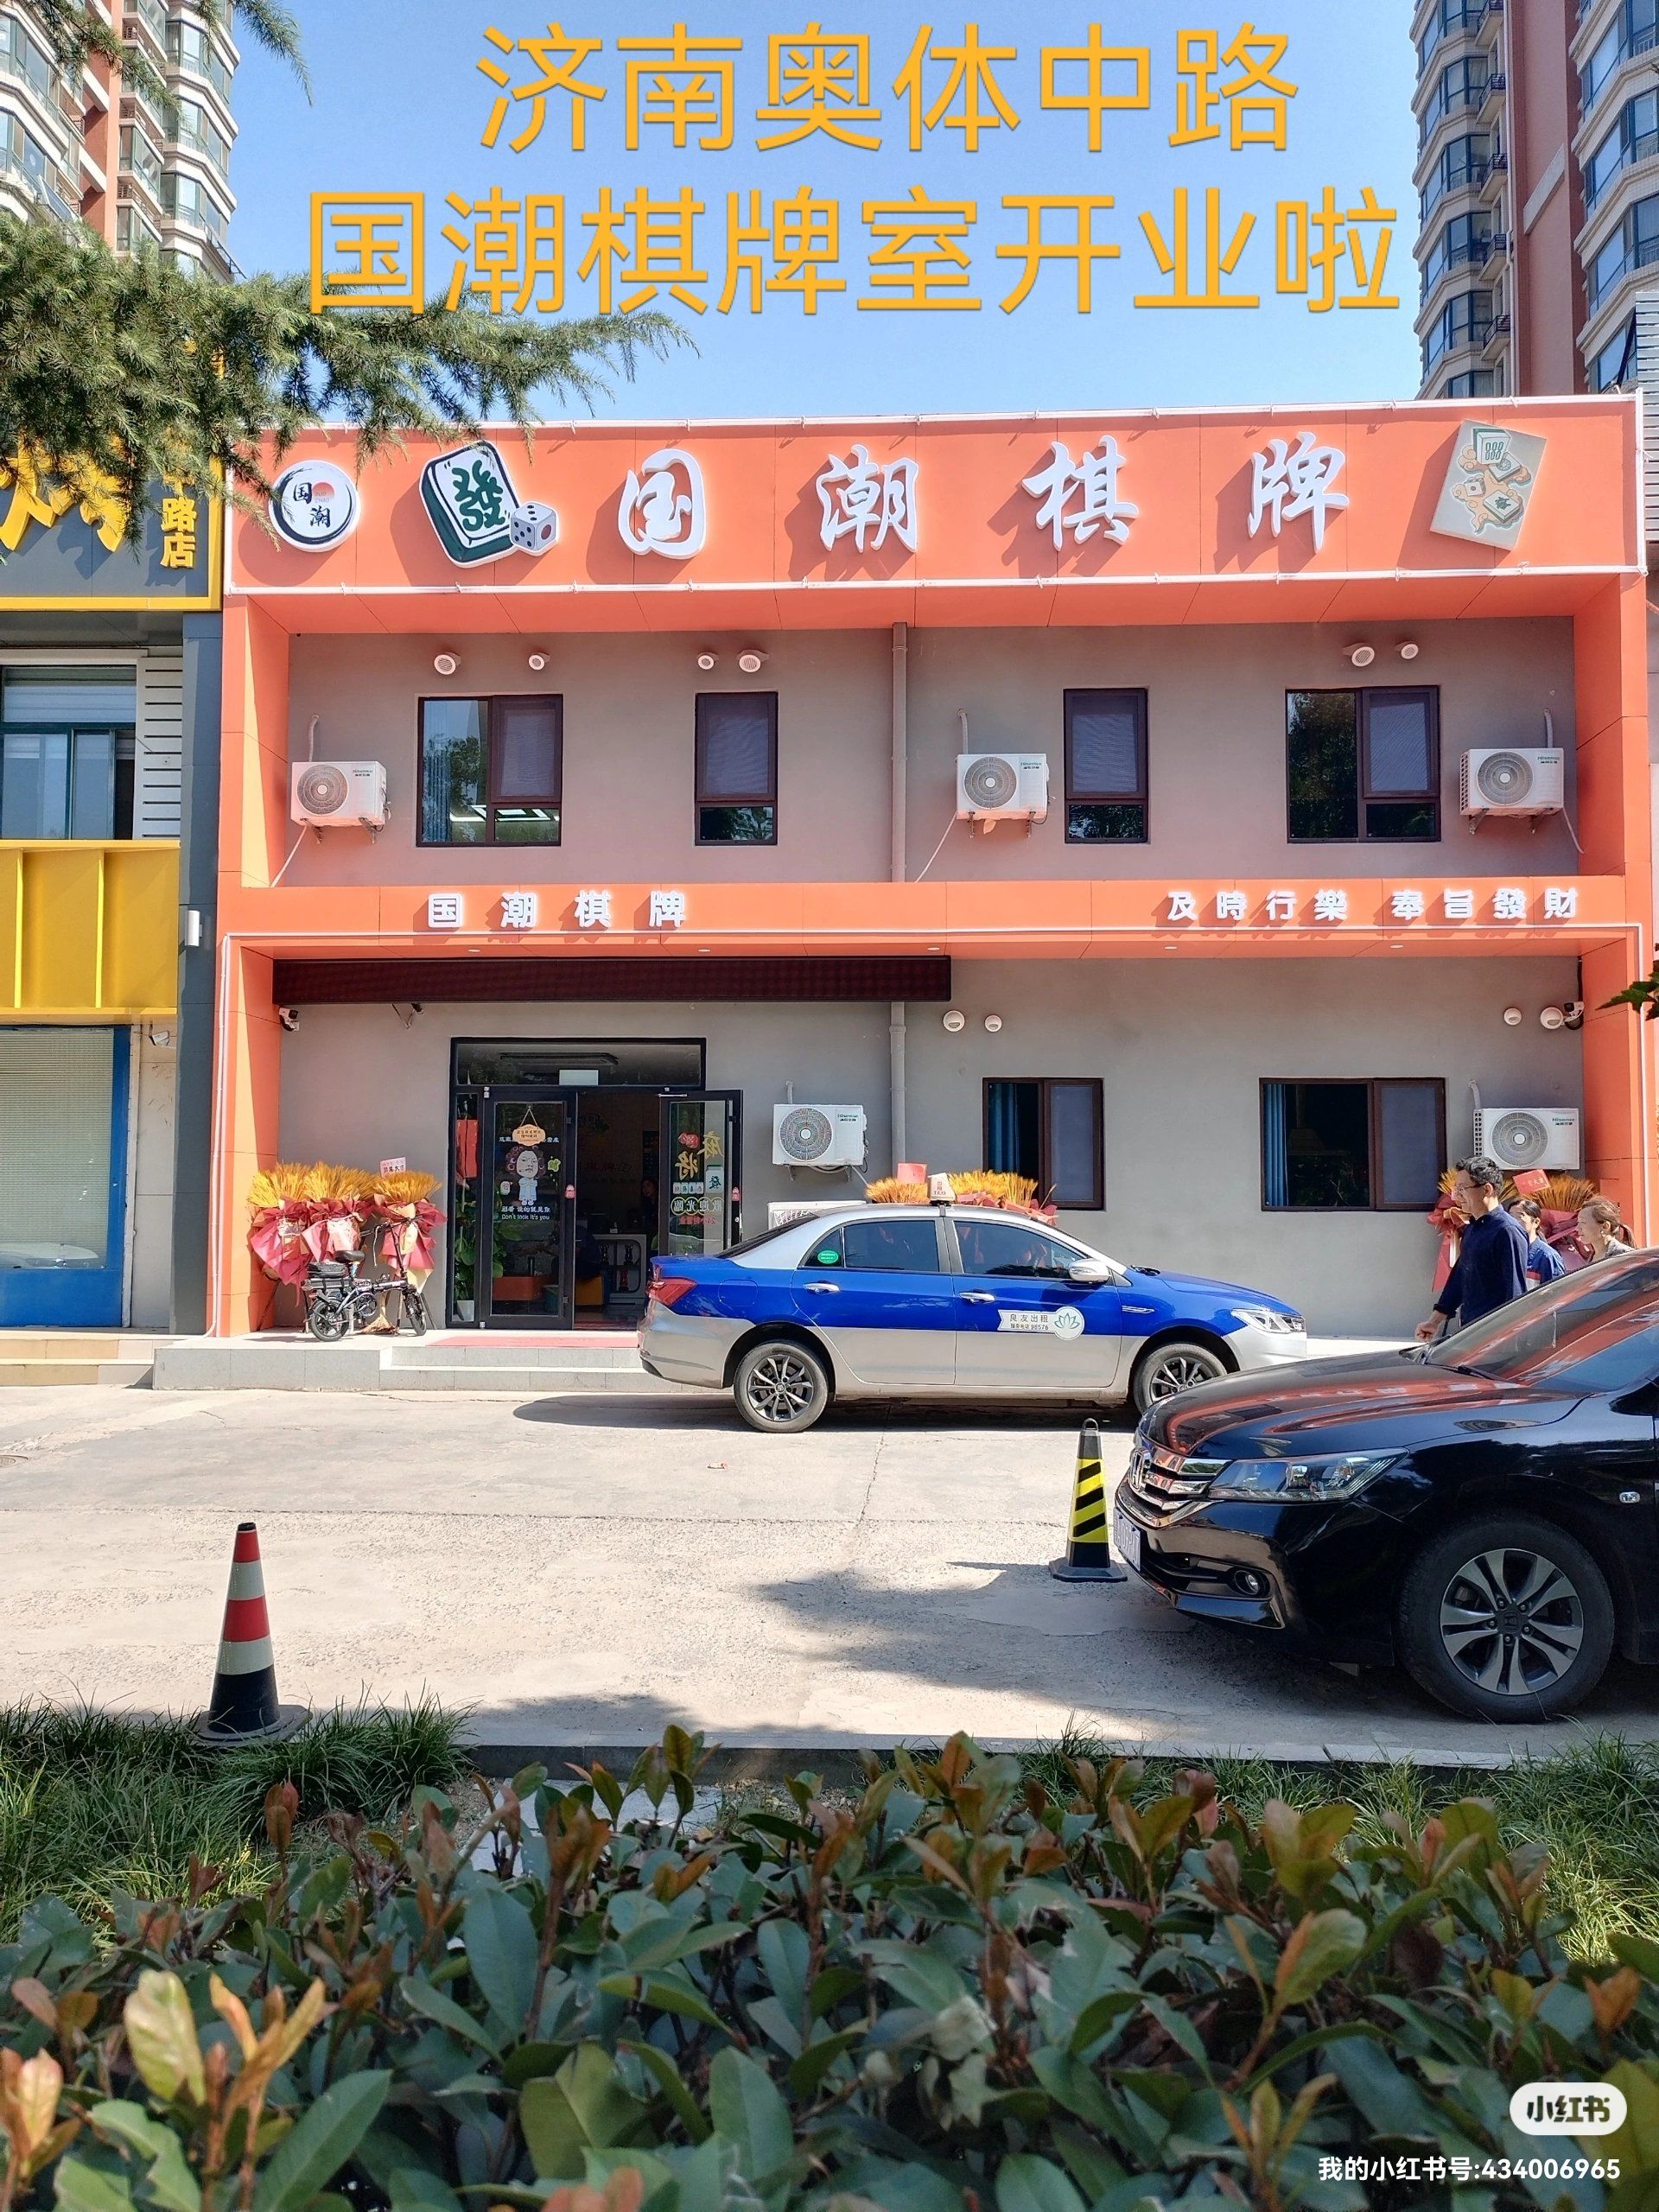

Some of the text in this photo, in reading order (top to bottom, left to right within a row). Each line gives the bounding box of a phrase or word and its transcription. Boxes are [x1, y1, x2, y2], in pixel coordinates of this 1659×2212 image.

[617, 431, 1350, 560] 国潮棋牌
[428, 889, 686, 929] 国潮棋牌
[1167, 887, 1578, 922] 及時行樂 奉旨發財
[1009, 1313, 1049, 1323] 良友出租
